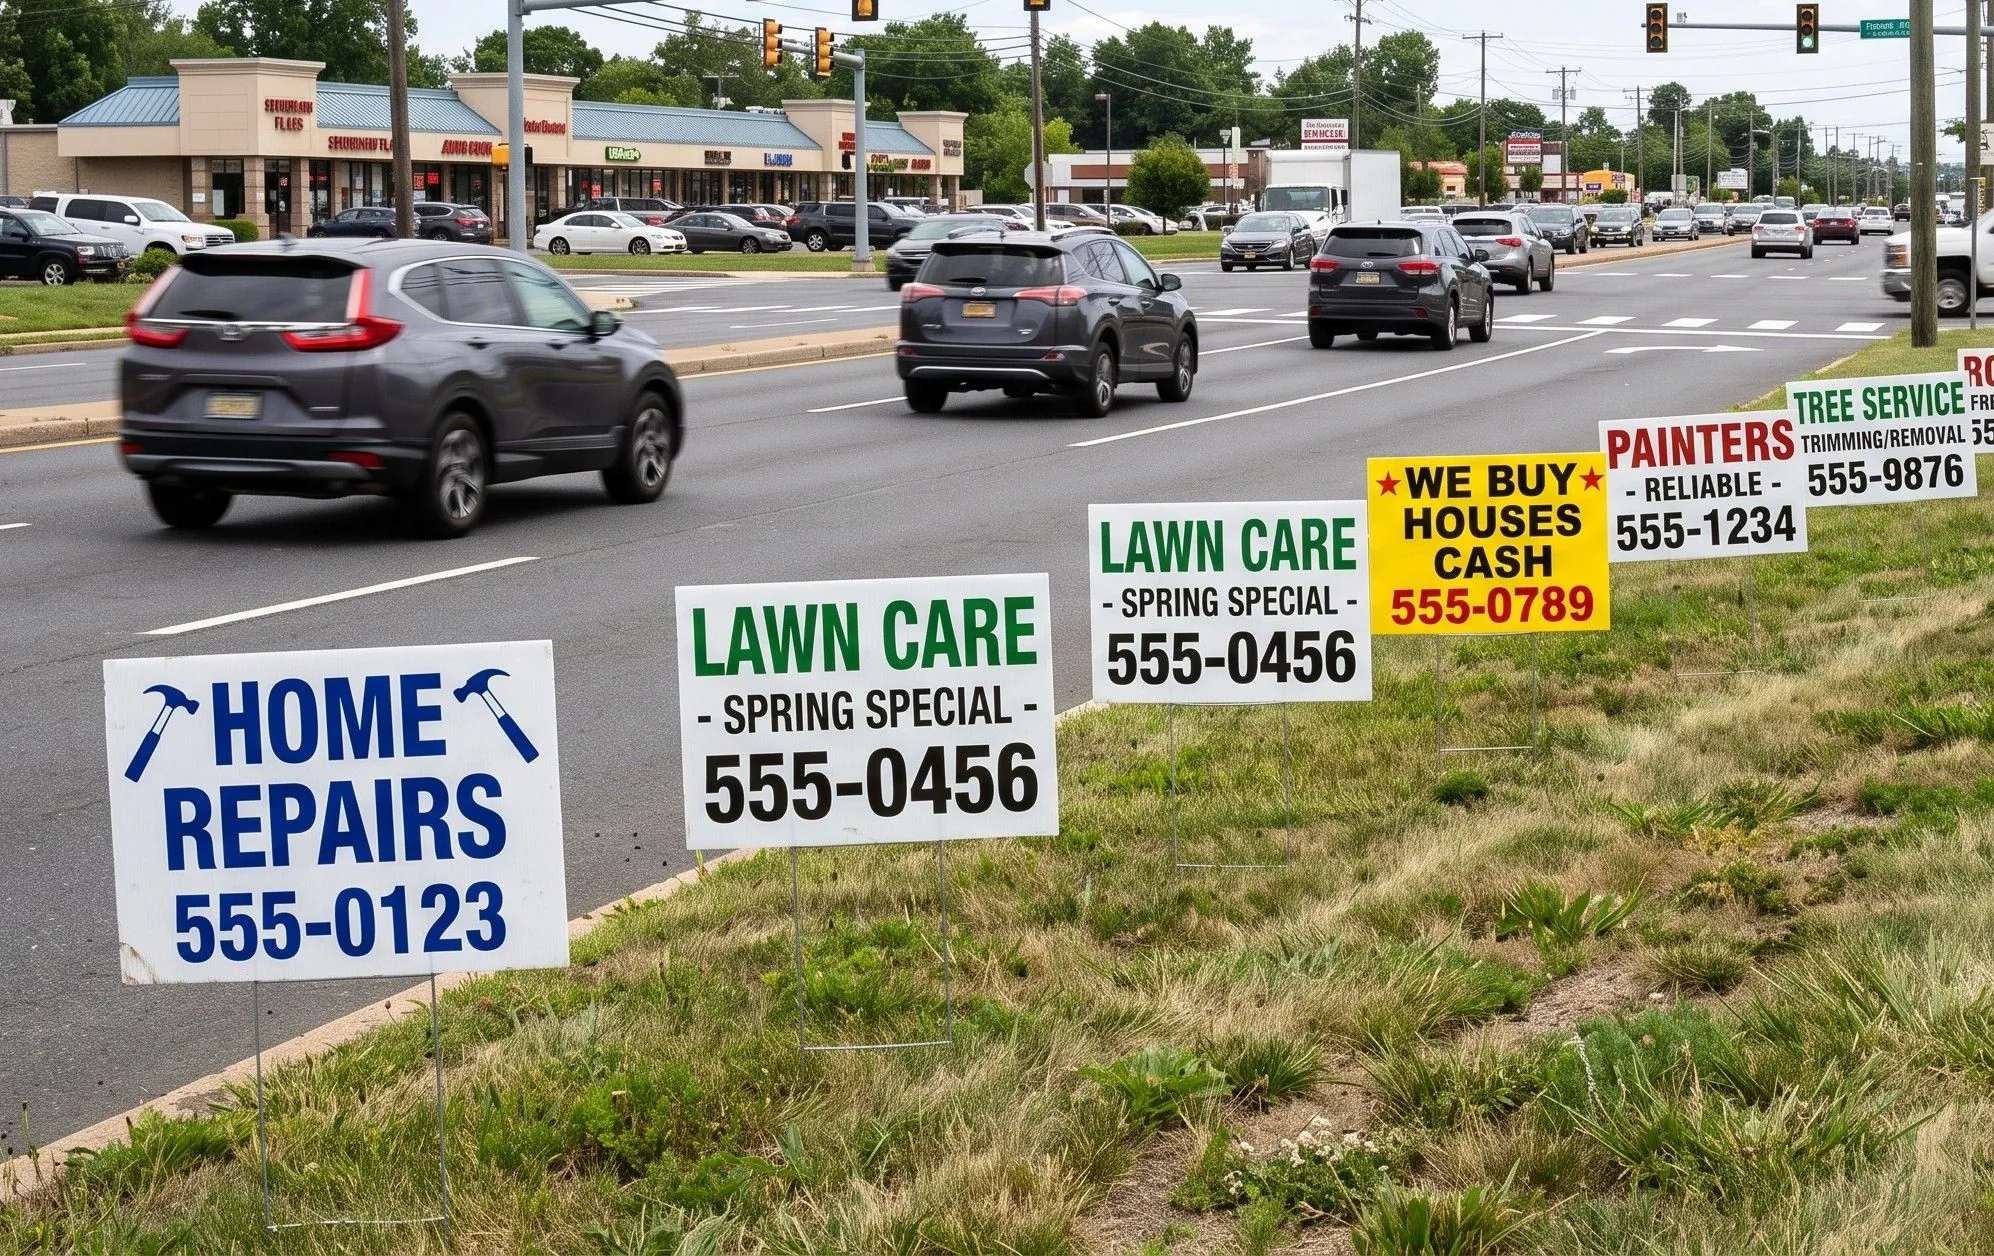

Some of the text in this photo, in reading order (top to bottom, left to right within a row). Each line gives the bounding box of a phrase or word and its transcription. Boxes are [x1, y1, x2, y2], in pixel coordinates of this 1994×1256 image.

[1794, 382, 1965, 424] TREE SERVICE
[1608, 420, 1794, 469] PAINTERS
[1801, 425, 1966, 453] TRIMMING/REMOVAL
[1405, 463, 1577, 499] WE BUY
[1646, 472, 1762, 501] RELIABLE
[1809, 454, 1964, 496] 555-9876
[1405, 504, 1581, 539] HOUSES
[1617, 505, 1796, 552] 555-1234
[1101, 518, 1356, 573] LAWN CARE
[1435, 545, 1551, 579] CASH
[1122, 587, 1218, 617] SPRING
[1229, 586, 1338, 616] SPECIAL
[1392, 586, 1593, 625] 555-0789
[693, 597, 1037, 676] LAWN CARE
[1108, 630, 1355, 685] 555-0456
[212, 673, 446, 765] HOME
[724, 691, 853, 734] SPRING
[867, 686, 1012, 729] SPECIAL
[706, 743, 1038, 823] 555-0456
[164, 773, 506, 870] REPAIRS
[176, 881, 506, 963] 555-0123
